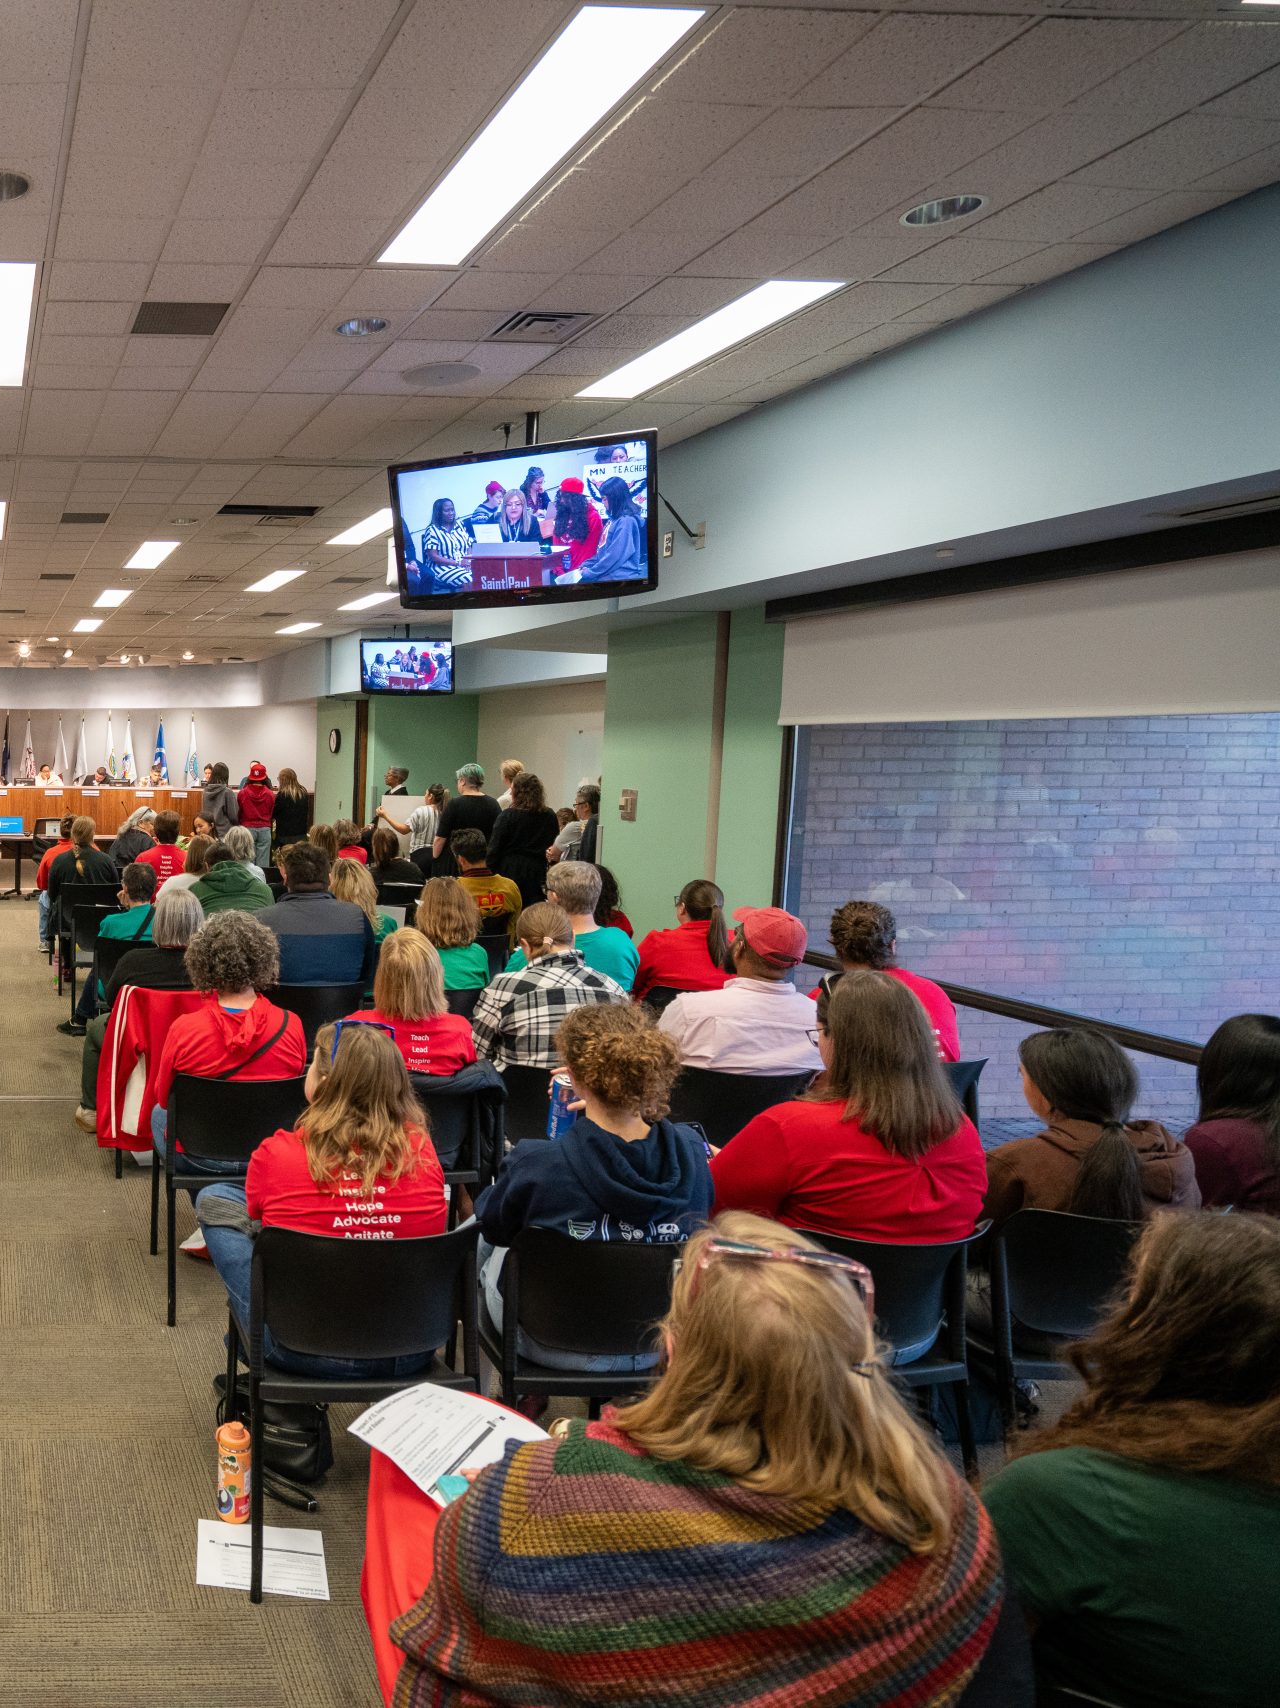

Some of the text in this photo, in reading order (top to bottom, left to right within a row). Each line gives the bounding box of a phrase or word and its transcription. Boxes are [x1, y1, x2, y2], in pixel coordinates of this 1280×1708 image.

[590, 468, 606, 476] MN
[480, 576, 530, 590] Saint Paul
[346, 1202, 384, 1212] Hope
[332, 1214, 402, 1228] Advocate
[344, 1230, 394, 1239] Agitate
